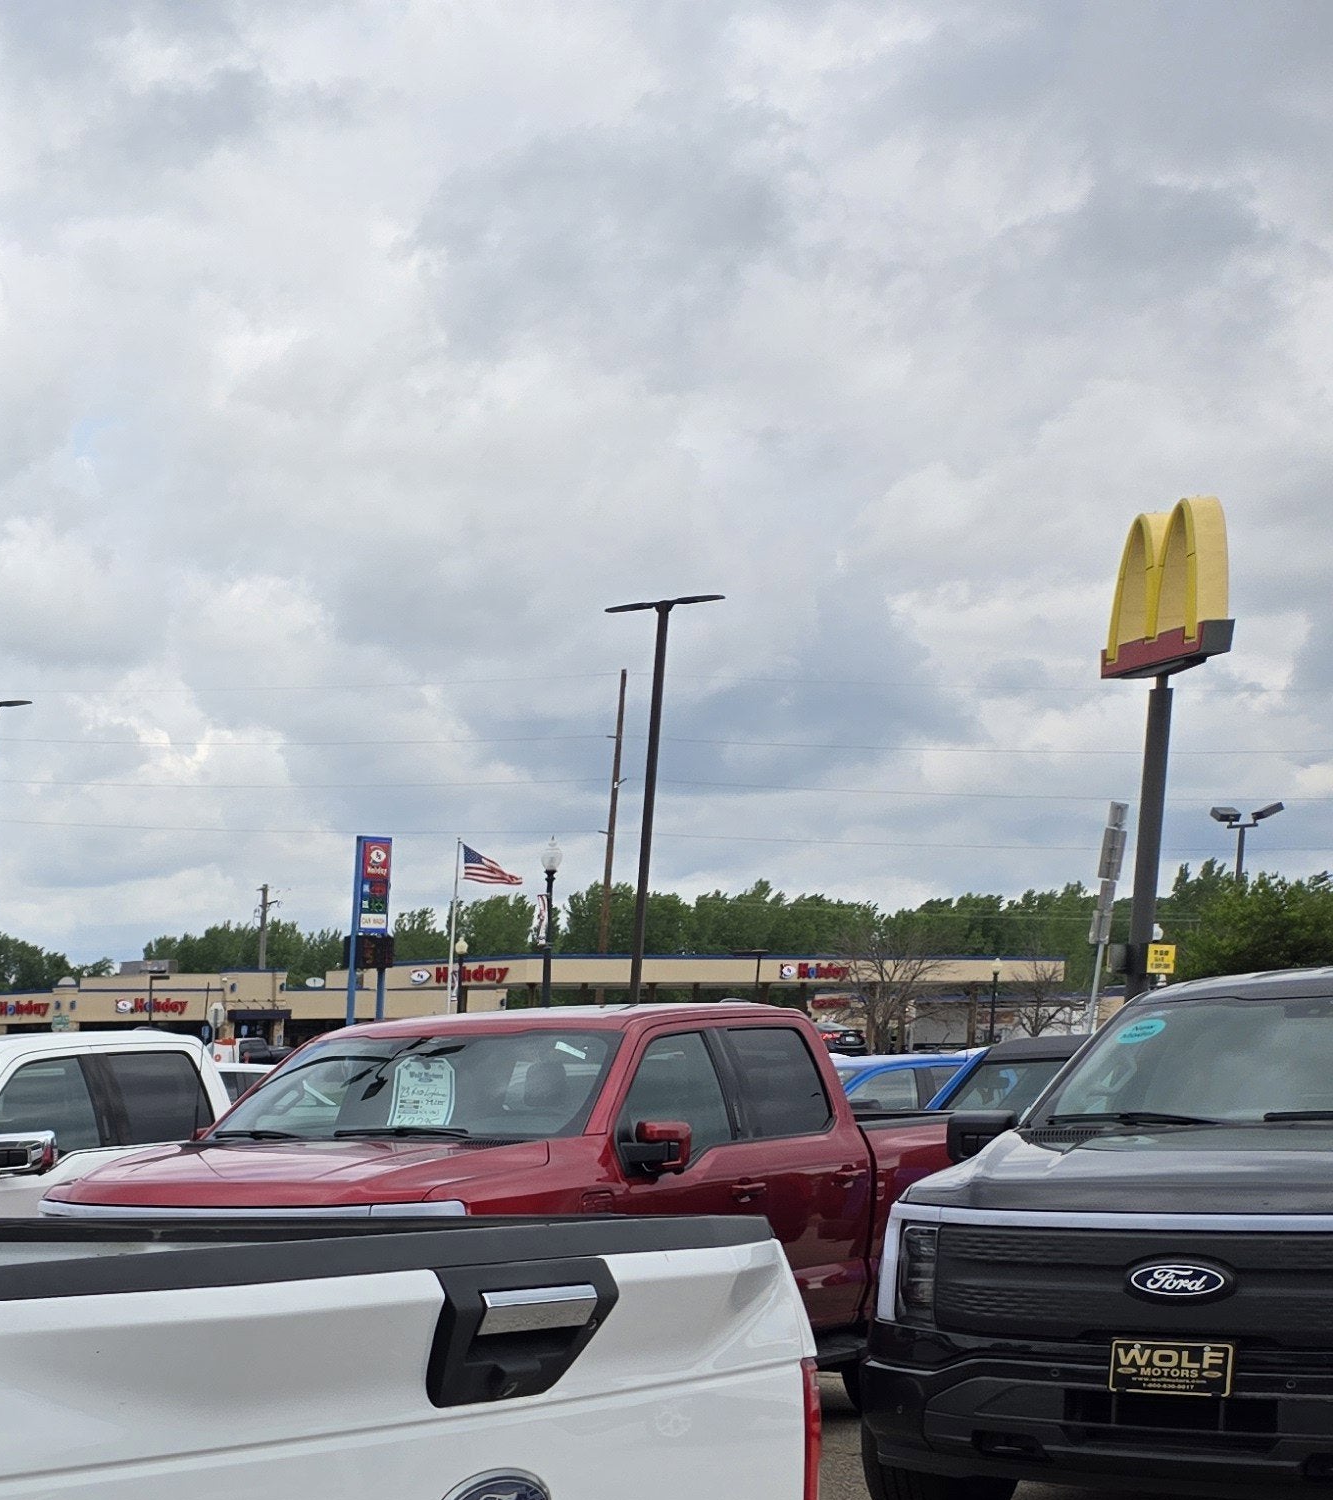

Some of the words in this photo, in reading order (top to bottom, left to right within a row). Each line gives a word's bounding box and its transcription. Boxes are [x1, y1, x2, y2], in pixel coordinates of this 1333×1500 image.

[435, 964, 509, 984] Hliday
[1146, 1268, 1208, 1291] Ford
[1117, 1347, 1225, 1369] WOLF
[1139, 1367, 1199, 1378] MOTORS
